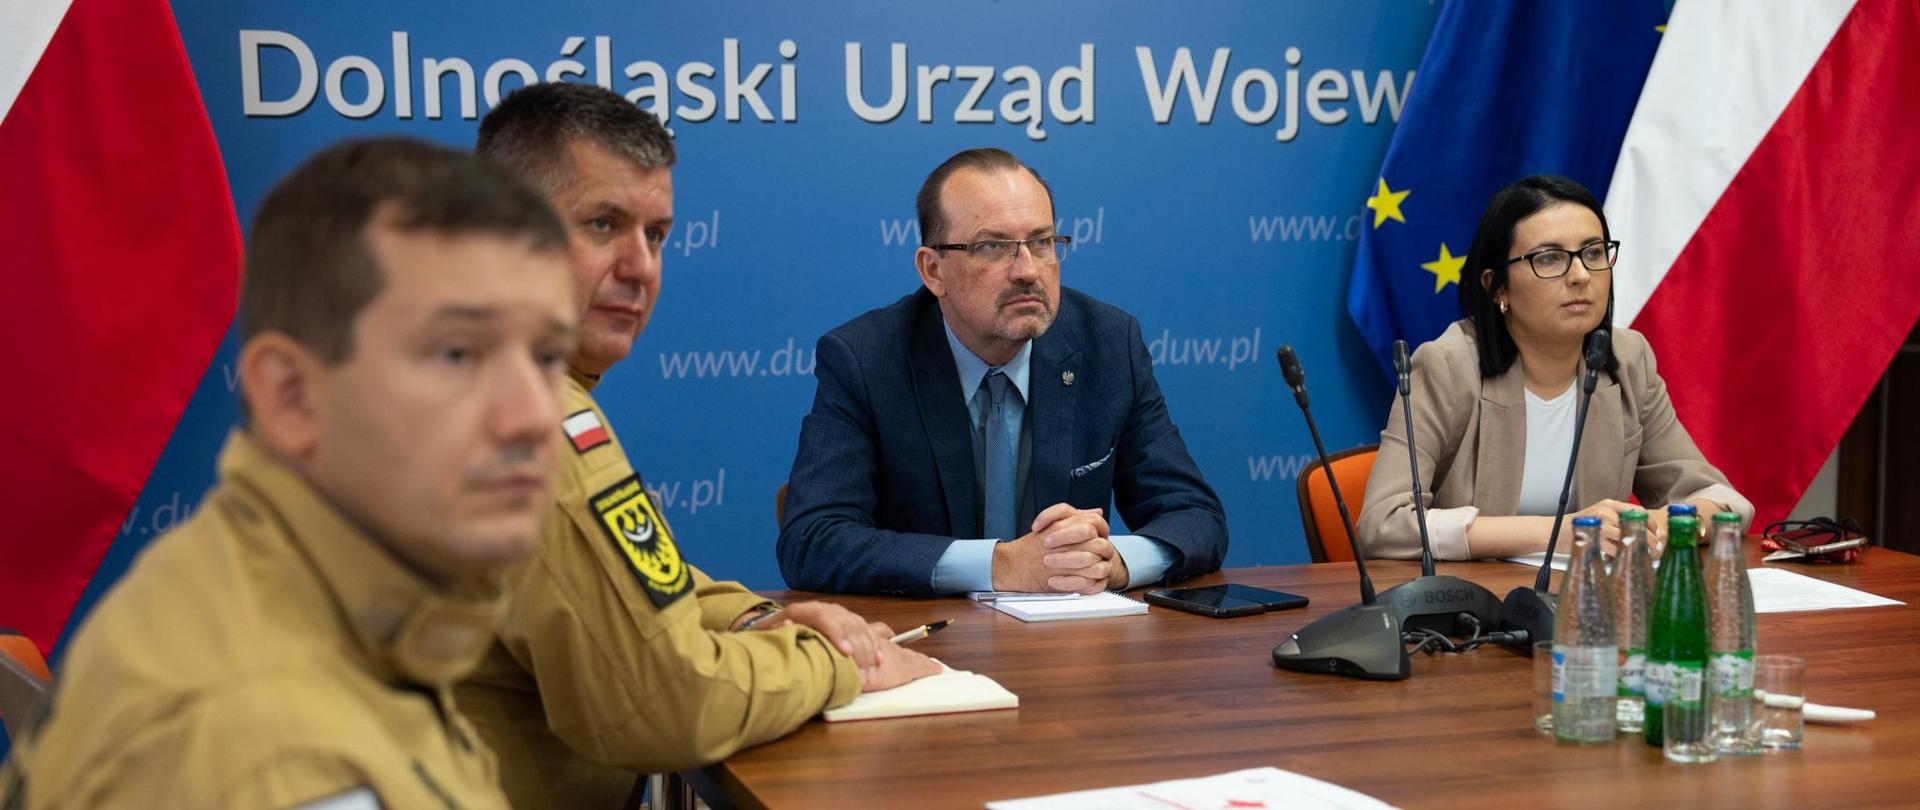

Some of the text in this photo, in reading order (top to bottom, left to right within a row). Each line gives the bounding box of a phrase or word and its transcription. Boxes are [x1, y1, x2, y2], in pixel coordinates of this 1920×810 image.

[239, 29, 1417, 141] Dolnośląski Urząd Wojew
[1424, 588, 1474, 604] BOSCH
